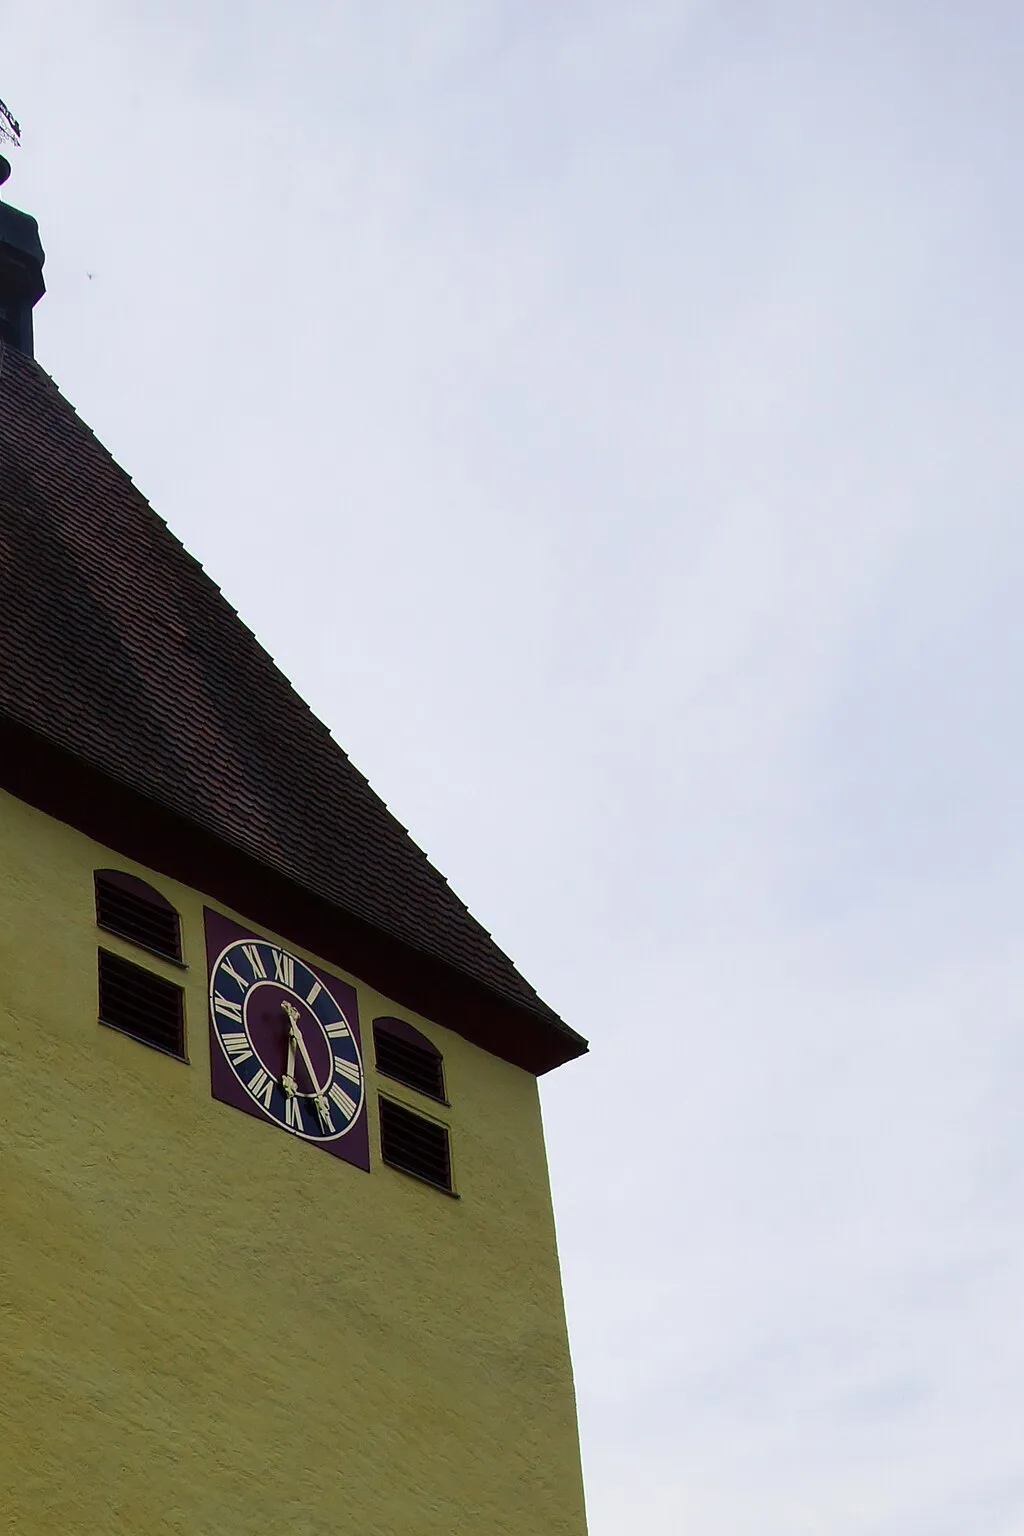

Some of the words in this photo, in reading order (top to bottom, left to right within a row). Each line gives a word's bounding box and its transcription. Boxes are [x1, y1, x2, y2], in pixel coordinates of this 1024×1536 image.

[220, 956, 249, 993] X
[241, 944, 268, 980] XI
[271, 949, 294, 989] XII
[214, 989, 243, 1024] IX
[306, 981, 323, 1006] I
[324, 1020, 350, 1039] II
[221, 1032, 253, 1066] VIII
[334, 1055, 360, 1085] III
[247, 1068, 275, 1110] VII
[285, 1097, 304, 1132] VI
